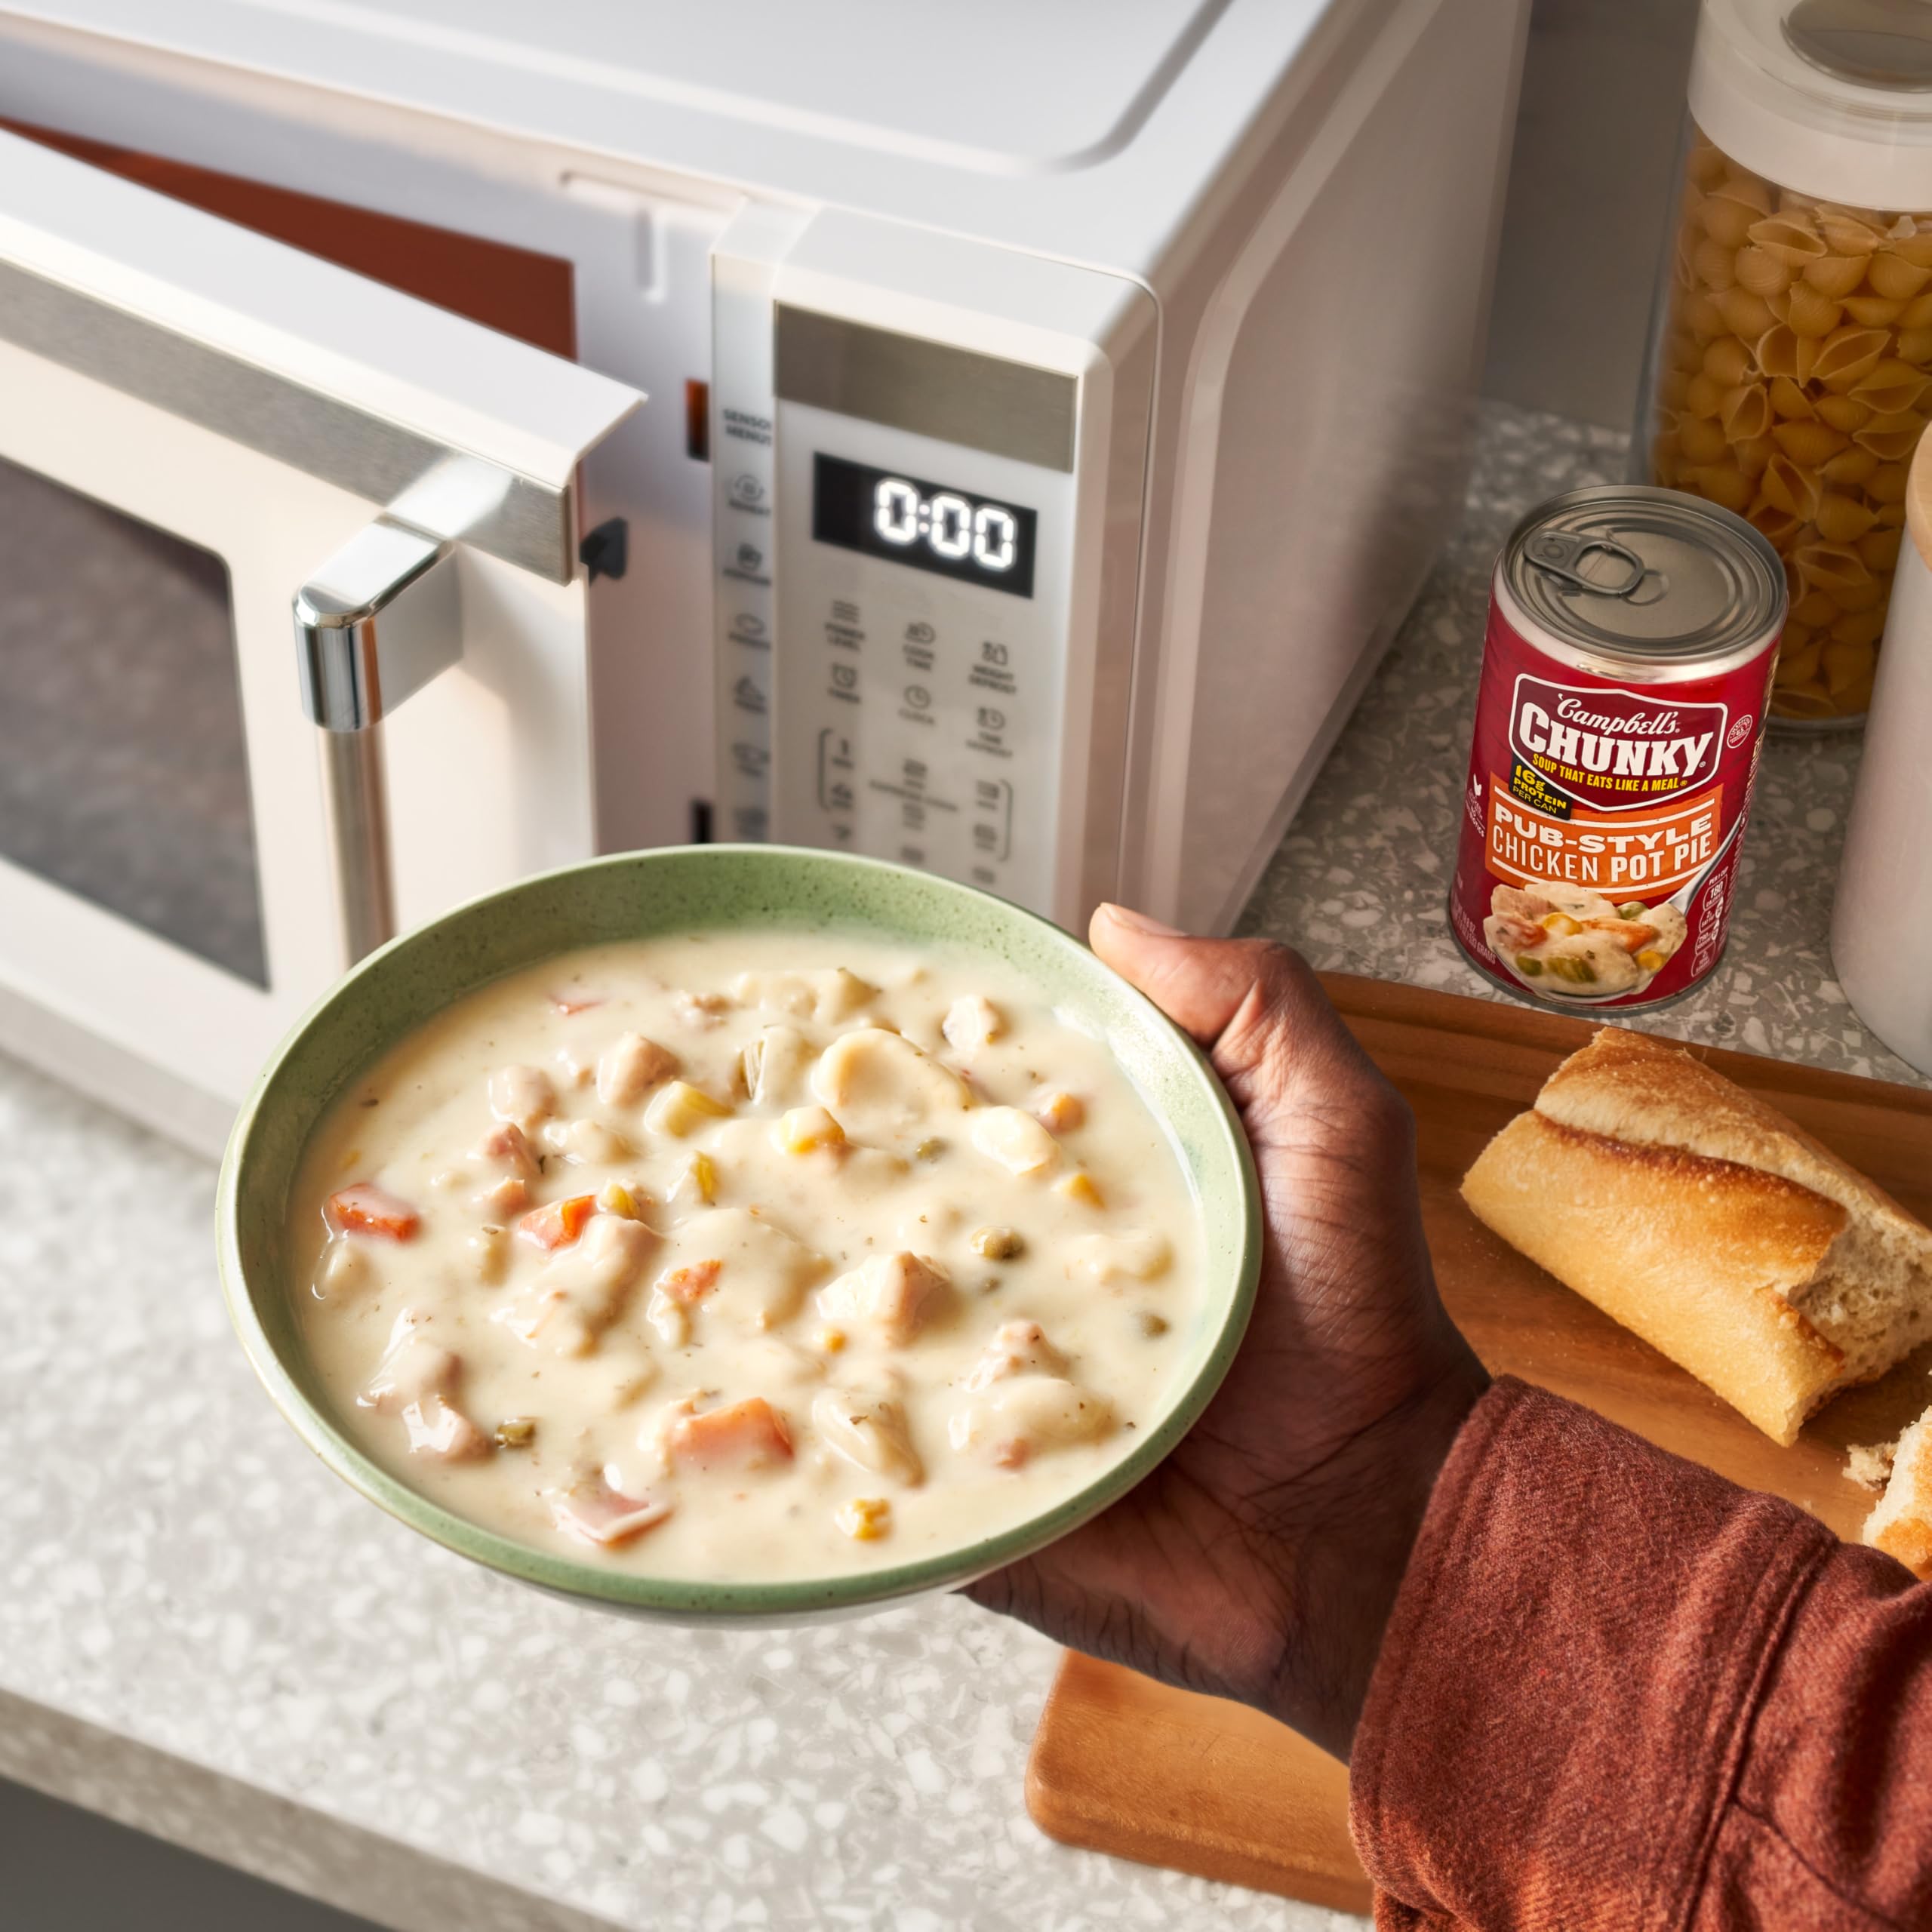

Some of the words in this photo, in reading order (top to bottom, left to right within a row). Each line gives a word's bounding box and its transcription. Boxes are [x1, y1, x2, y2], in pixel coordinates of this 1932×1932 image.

[875, 478, 1015, 570] 0:00
[1557, 693, 1679, 735] Campbell's
[1519, 702, 1714, 777] CHUNKY
[1515, 764, 1546, 792] 16g
[1533, 753, 1557, 774] SOUP
[1559, 765, 1585, 783] THAT
[1587, 774, 1613, 789] EATS
[1615, 780, 1638, 791] LIKE
[1641, 780, 1649, 791] A
[1651, 777, 1679, 791] MEAL
[1512, 786, 1531, 801] PER
[1534, 799, 1557, 814] CAN
[1514, 777, 1567, 809] PROTEIN
[1495, 802, 1712, 854] PUB-STYLE
[1492, 825, 1598, 881] CHICKEN
[1611, 851, 1664, 881] POT
[1674, 831, 1712, 870] PIE
[1710, 881, 1724, 898] 180
